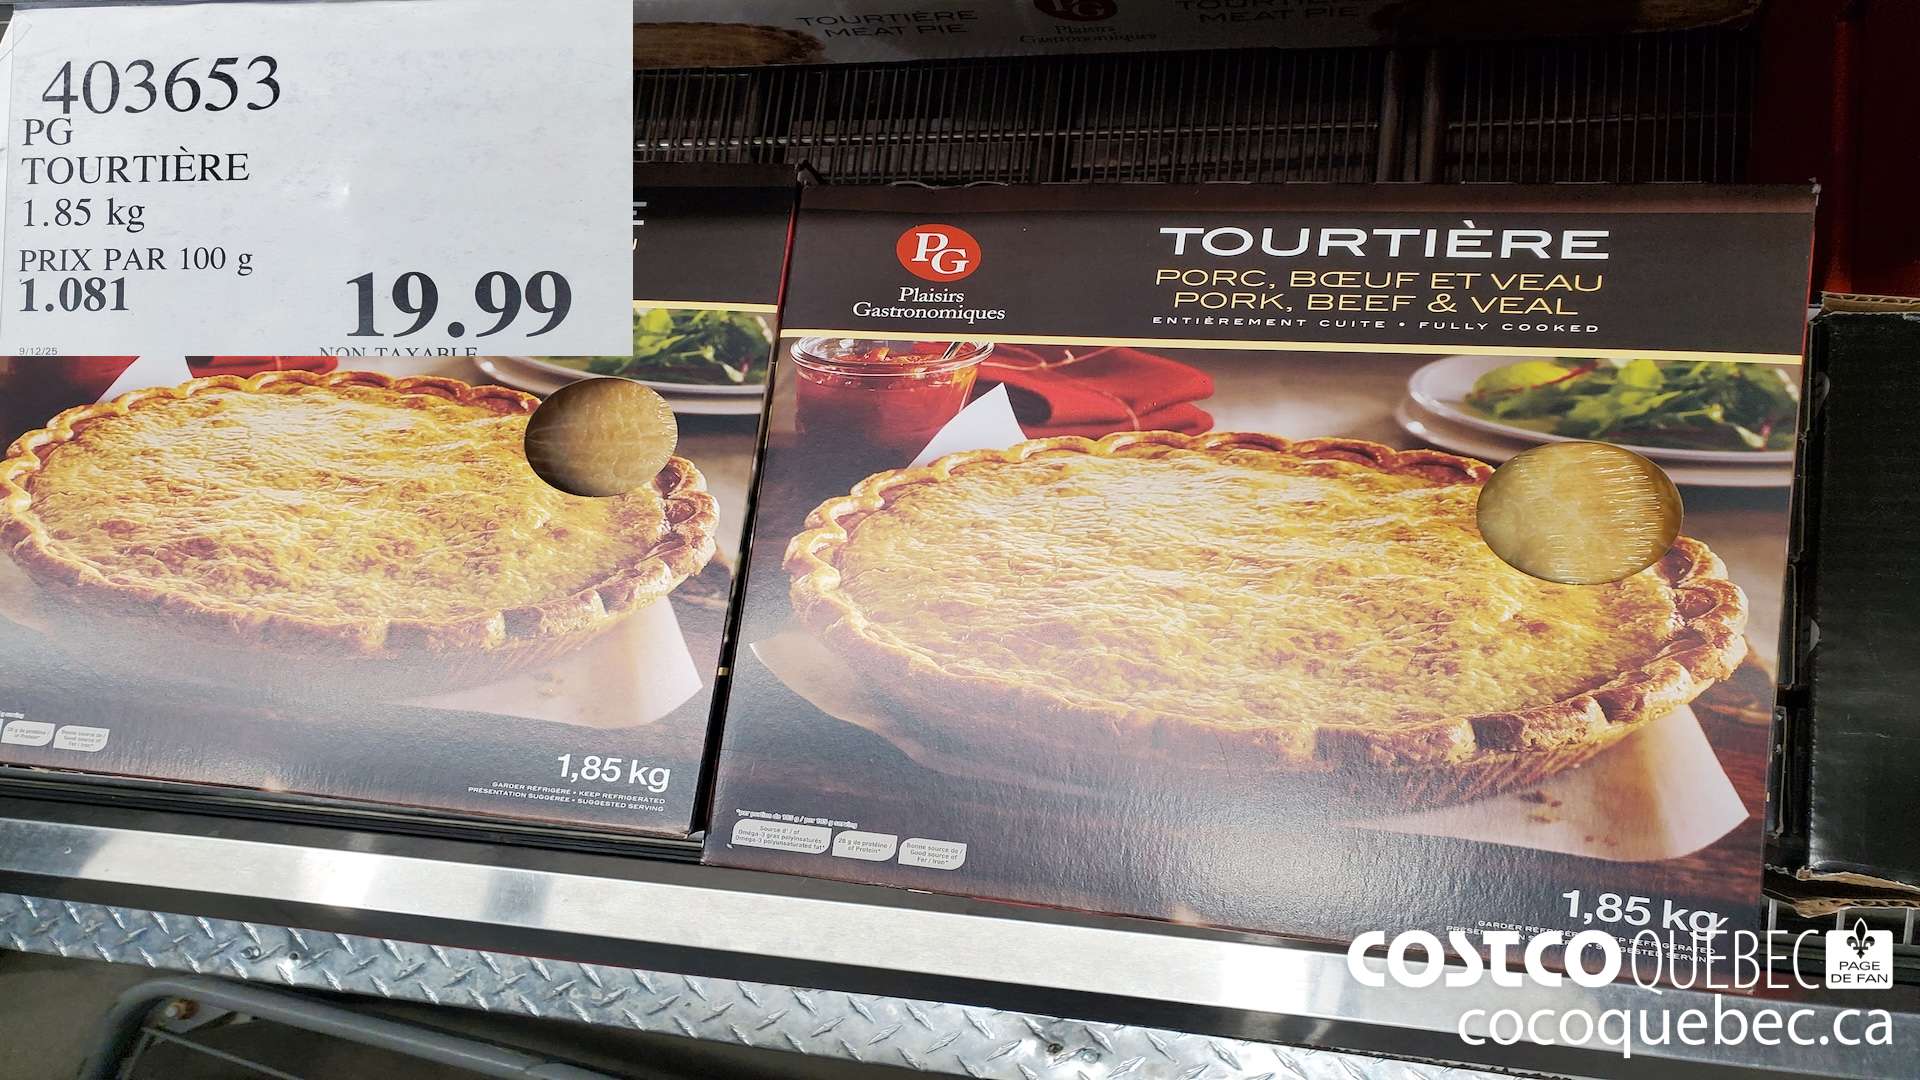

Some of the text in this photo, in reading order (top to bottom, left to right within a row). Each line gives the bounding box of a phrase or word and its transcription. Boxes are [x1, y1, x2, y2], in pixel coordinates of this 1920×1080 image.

[1199, 7, 1357, 22] MEAT PIE
[824, 24, 969, 38] MEAT PIE
[42, 55, 281, 115] 403653
[22, 118, 73, 146] PG
[21, 146, 250, 186] TOURTIÈRE
[23, 197, 145, 233] 1.85 kg
[1159, 220, 1610, 260] TOURTIÈRE
[19, 246, 254, 276] PRIX PAR 100 g
[911, 232, 970, 275] PG
[1155, 269, 1604, 291] PORC, BŒUF ET VEAU
[18, 276, 129, 313] 1.081
[346, 270, 572, 340] 19.99
[898, 287, 965, 303] Plaisirs
[1174, 292, 1578, 315] PORK, BEEF & VEAL
[852, 303, 1006, 324] Gastronomiques
[1152, 316, 1599, 332] ENTIÈREMENT CUITE FULLY COOKED
[19, 347, 58, 355] 9/12/25
[557, 753, 671, 793] 1,85 kg
[491, 781, 525, 790] GARDER
[578, 790, 601, 798] KEEP
[602, 793, 666, 804] REFRIGERATED
[577, 798, 627, 809] SUGGESTED
[628, 803, 664, 812] SERVING
[760, 825, 781, 833] Source
[1477, 920, 1523, 931] GARDER
[1562, 889, 1717, 942] 1,85 kg
